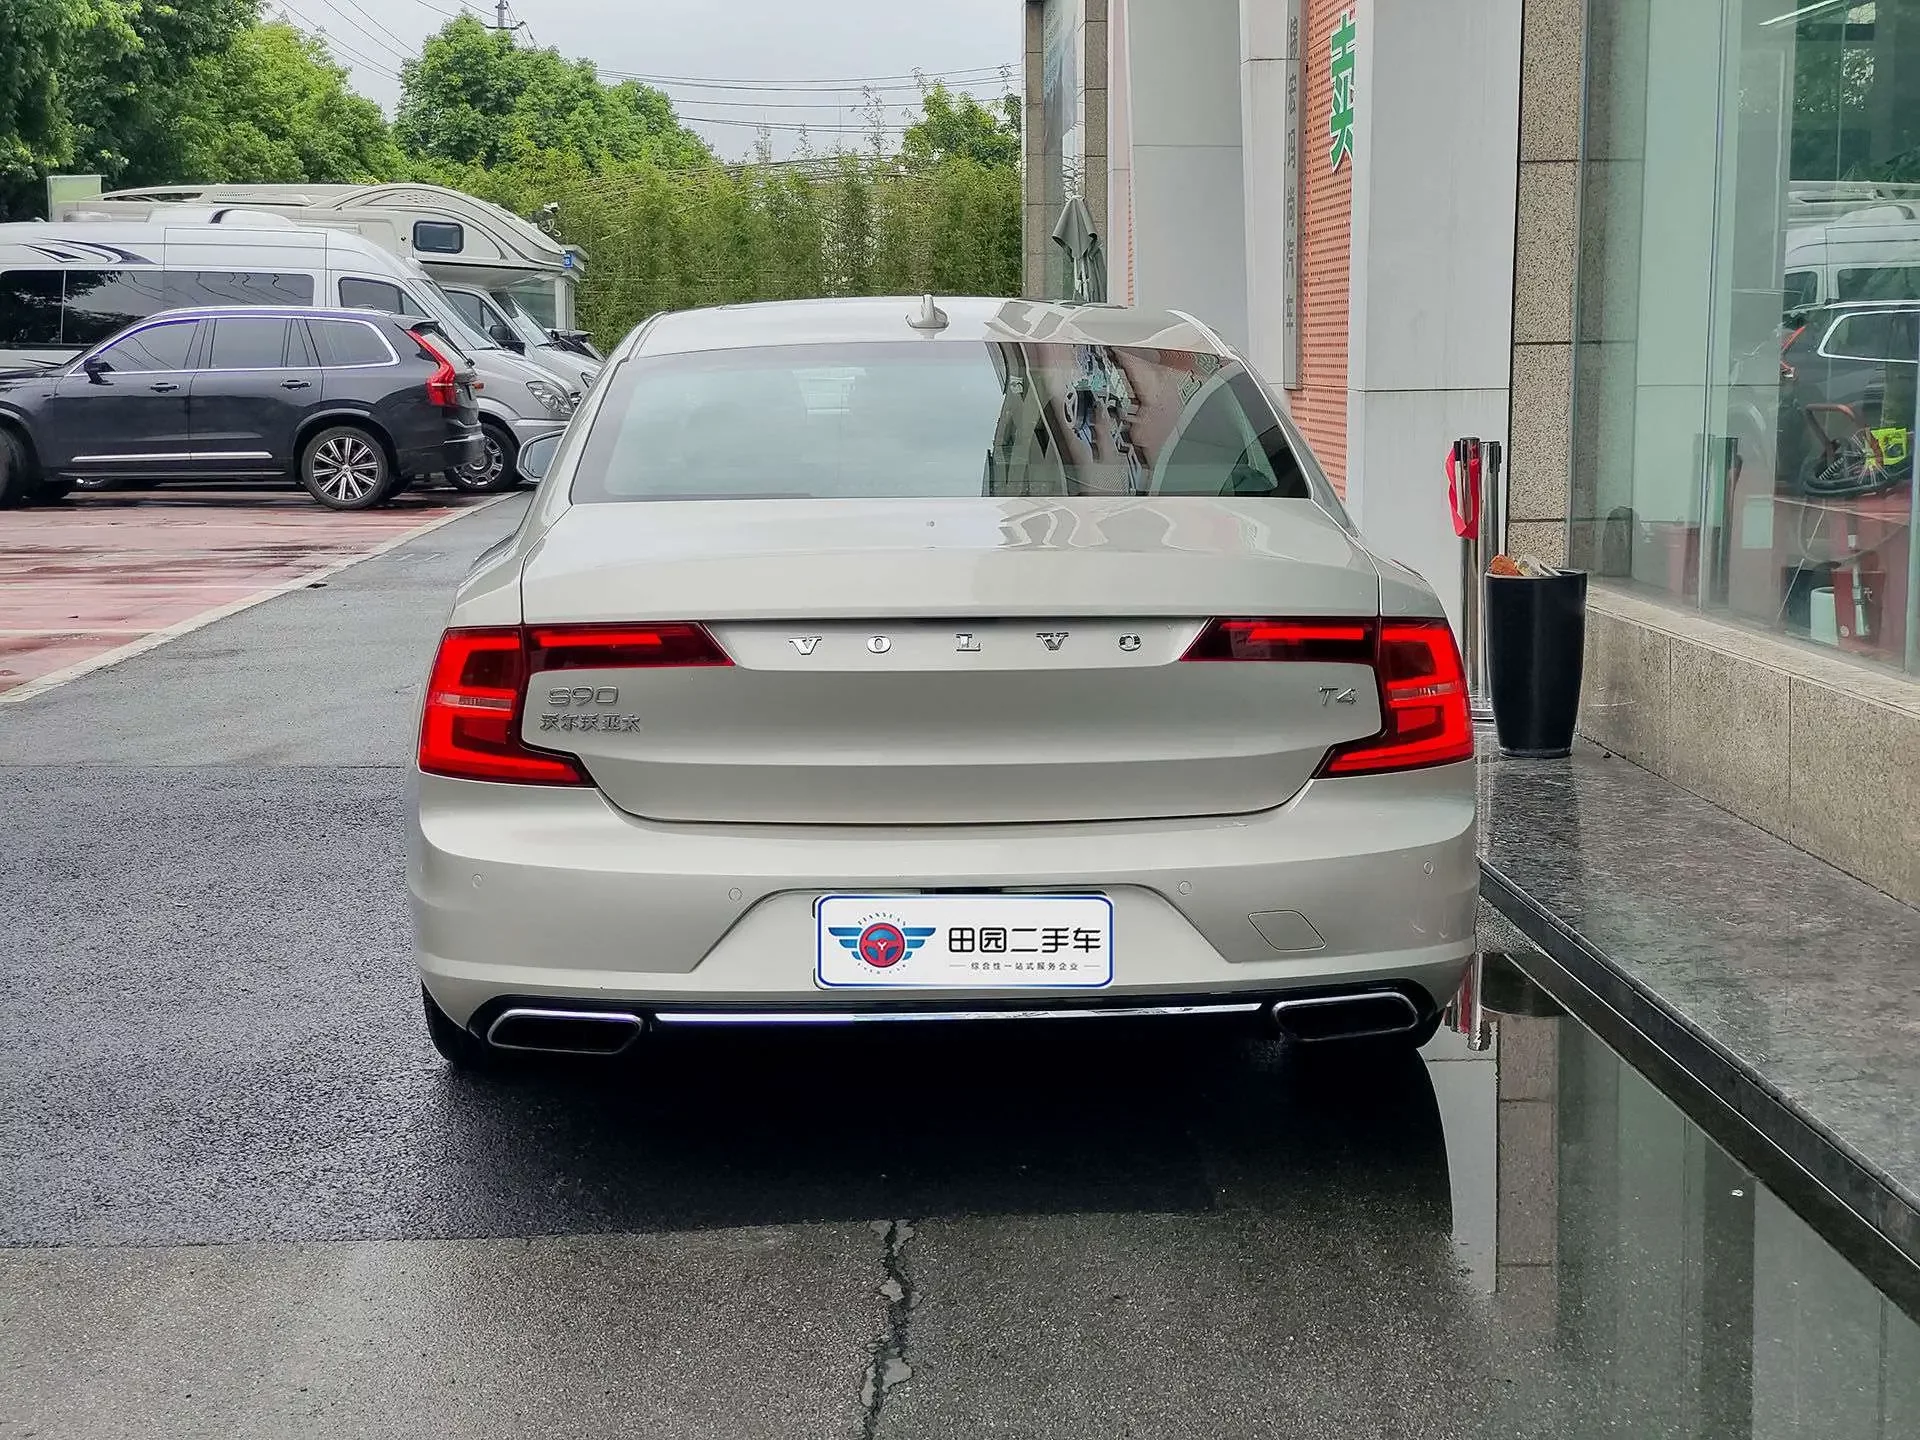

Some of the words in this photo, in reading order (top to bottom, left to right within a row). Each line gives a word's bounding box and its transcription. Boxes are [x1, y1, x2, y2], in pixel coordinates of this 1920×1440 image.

[788, 631, 1143, 656] VOLVO
[548, 686, 619, 707] S90
[1319, 686, 1357, 706] T4
[540, 712, 641, 733] 沃尔沃亚太
[948, 926, 1102, 954] 田园二手车
[970, 961, 1078, 971] 综合性一站式服务企业
